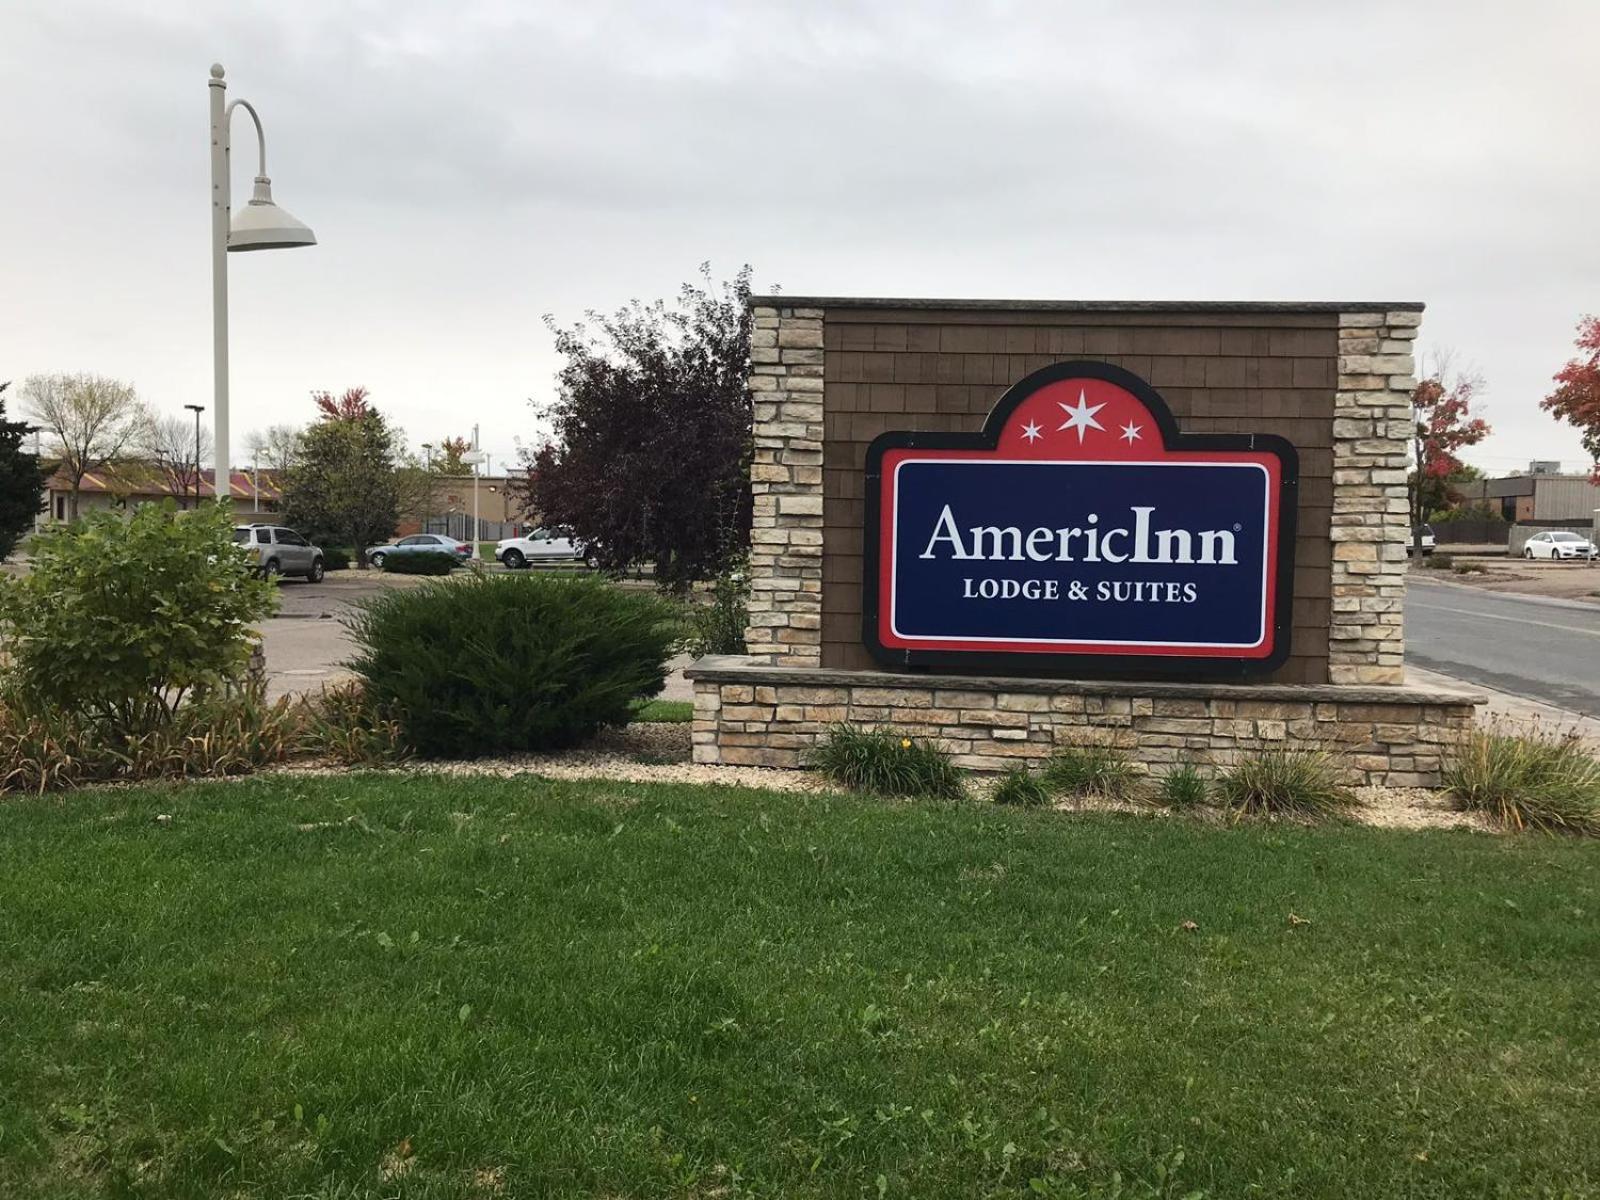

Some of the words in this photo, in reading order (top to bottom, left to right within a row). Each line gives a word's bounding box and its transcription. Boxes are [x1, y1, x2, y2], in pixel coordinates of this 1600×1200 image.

[920, 504, 1239, 564] AmericInn
[963, 578, 1059, 600] LODGE
[1068, 580, 1089, 601] &
[1097, 581, 1197, 603] SUITES
